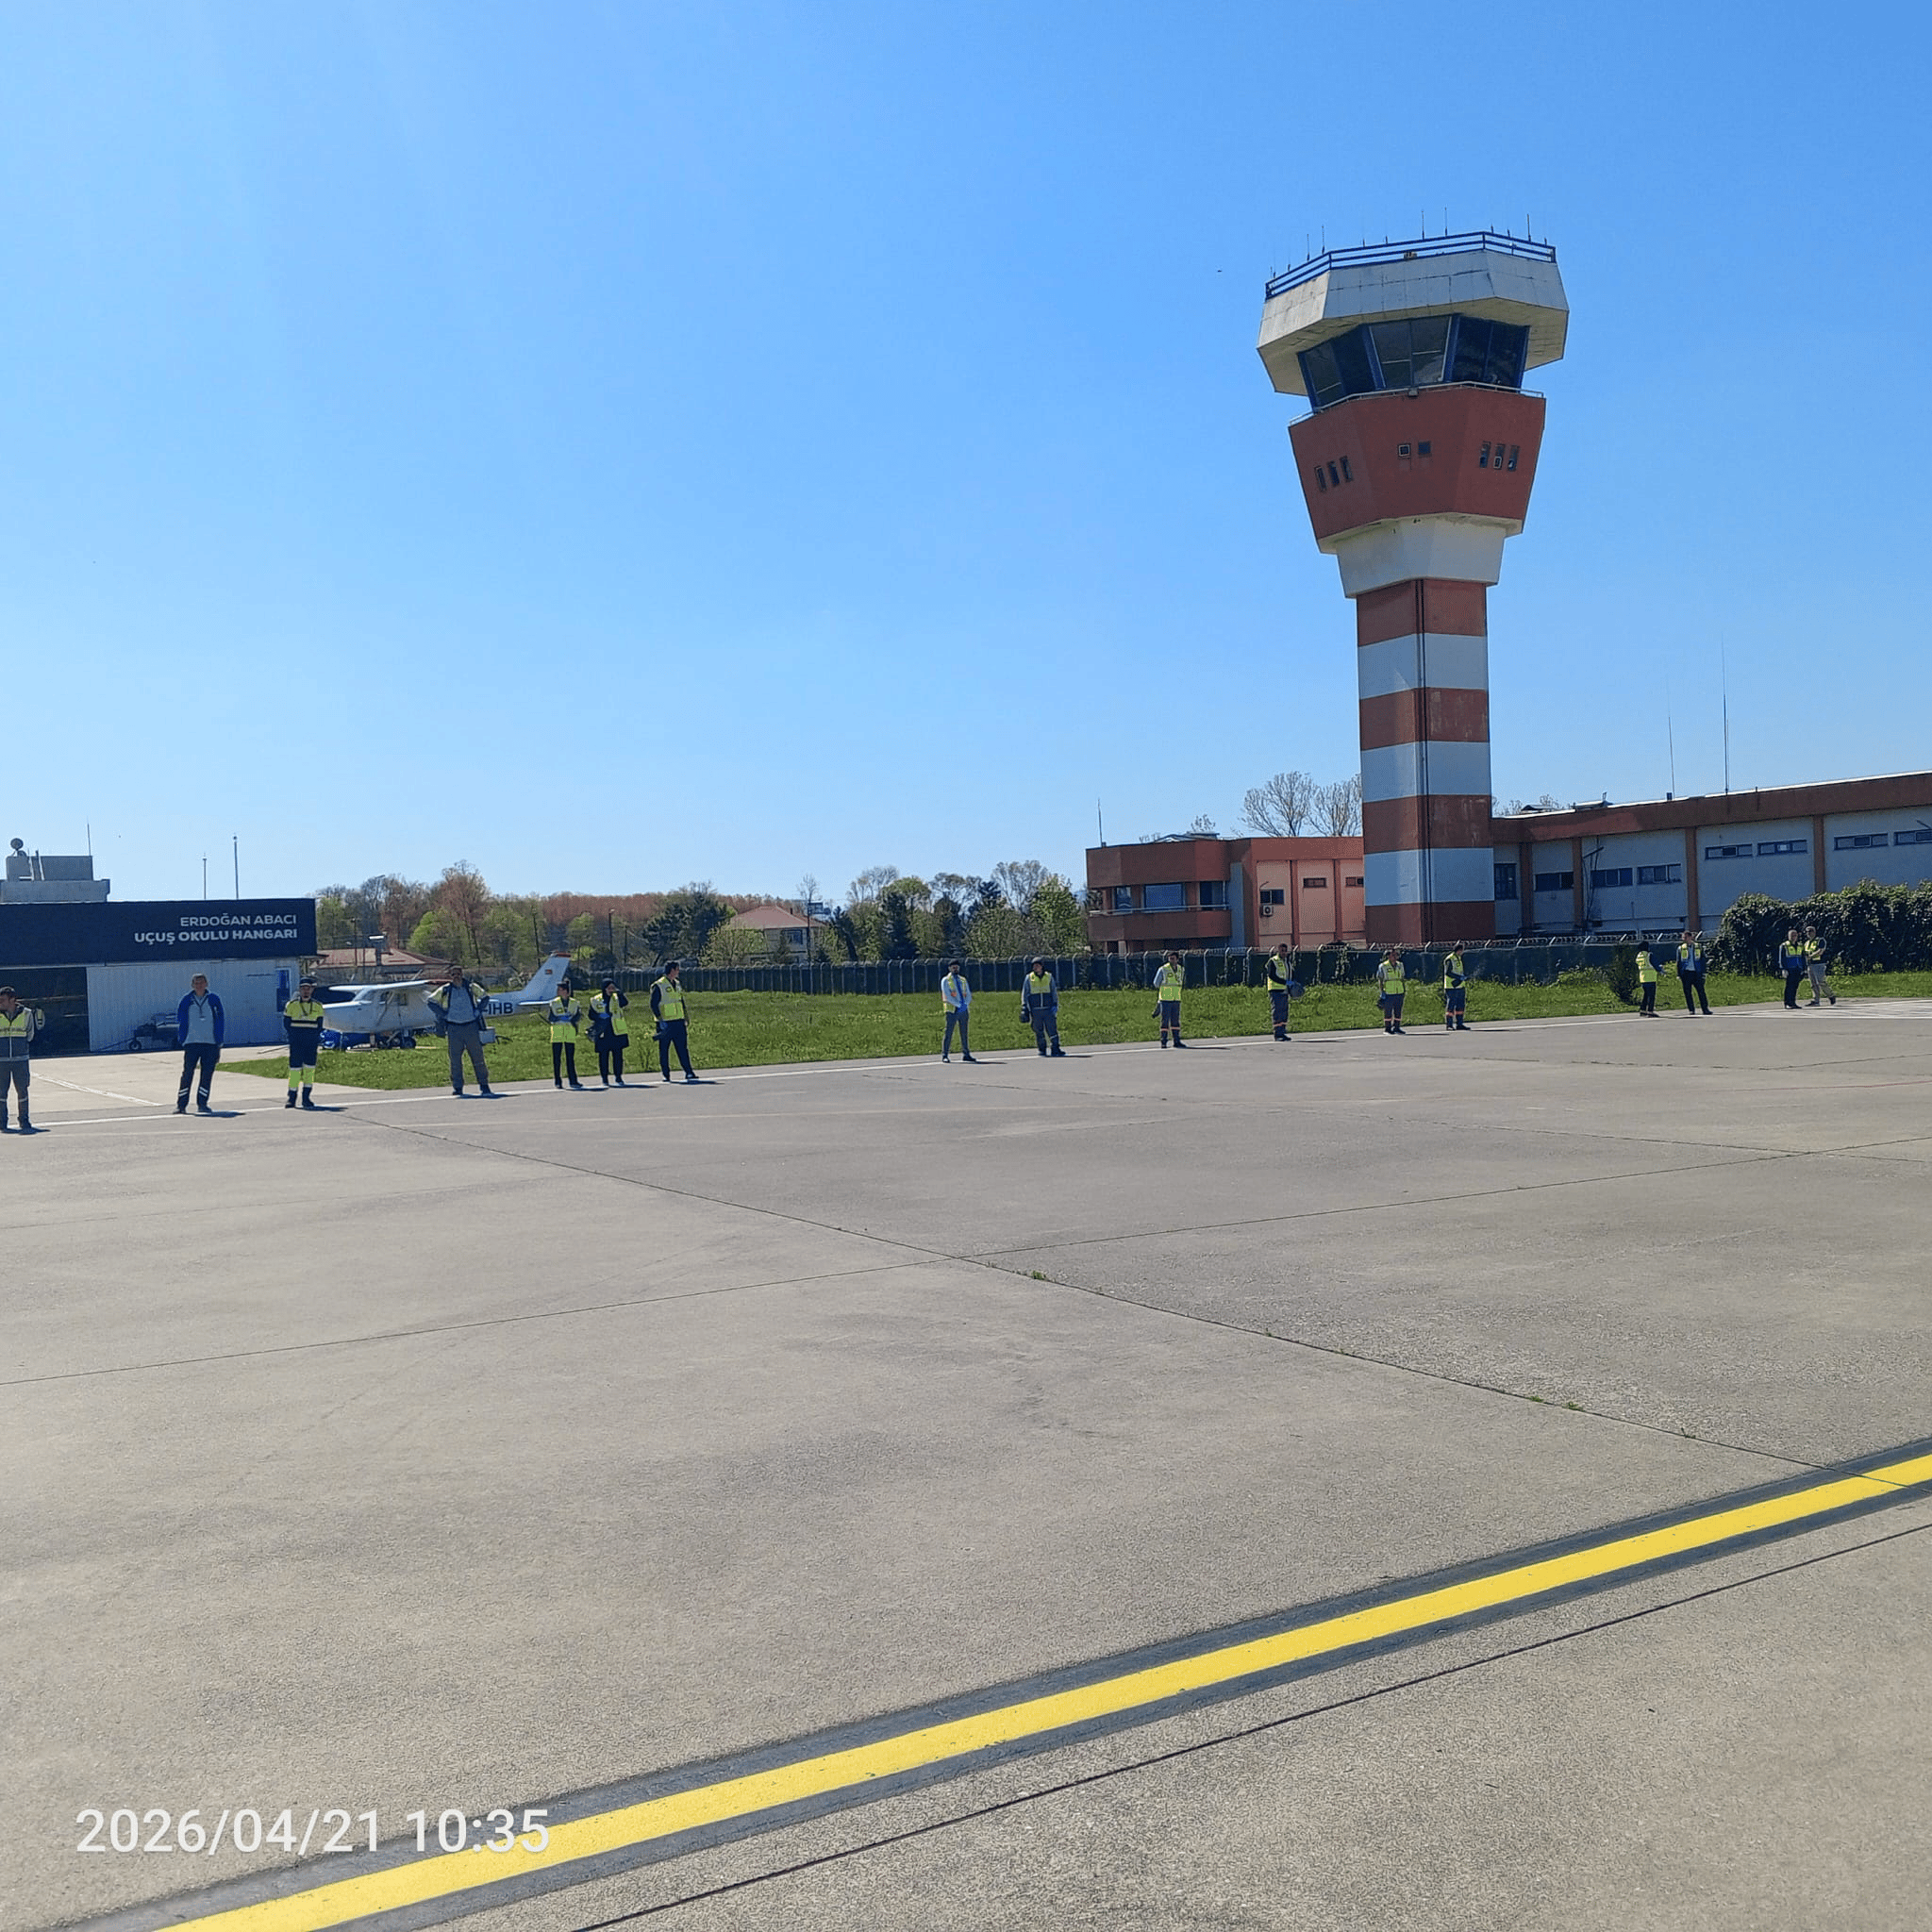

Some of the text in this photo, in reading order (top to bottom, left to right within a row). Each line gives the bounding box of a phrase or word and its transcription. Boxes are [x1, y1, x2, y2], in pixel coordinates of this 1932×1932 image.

[180, 912, 297, 926] ERDOĞAN ABACI
[134, 928, 298, 945] UÇUŞ OKULU HANGARI
